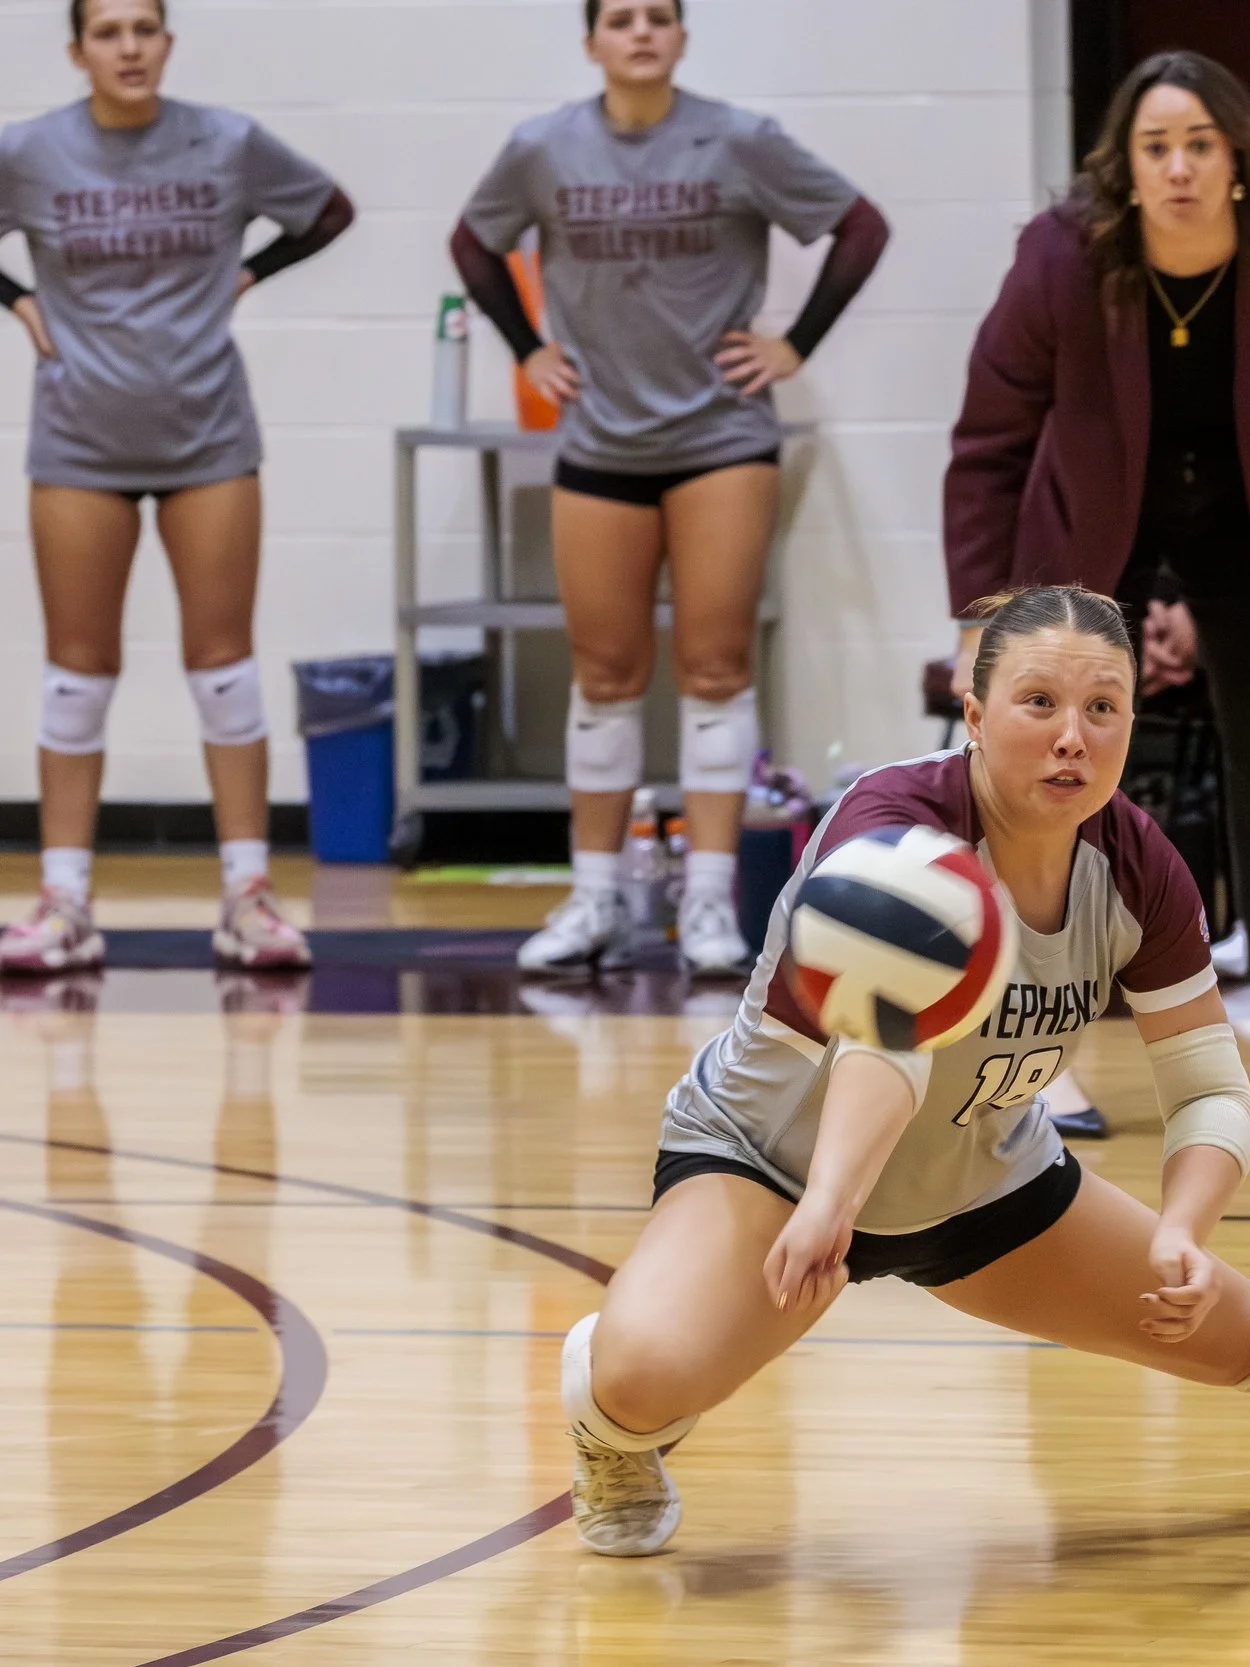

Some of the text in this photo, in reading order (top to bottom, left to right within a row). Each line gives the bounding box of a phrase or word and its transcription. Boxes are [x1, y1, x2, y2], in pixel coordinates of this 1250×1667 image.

[53, 181, 218, 222] STEPHENS
[556, 181, 720, 218] STEPHENS
[980, 979, 1098, 1039] EPHEN
